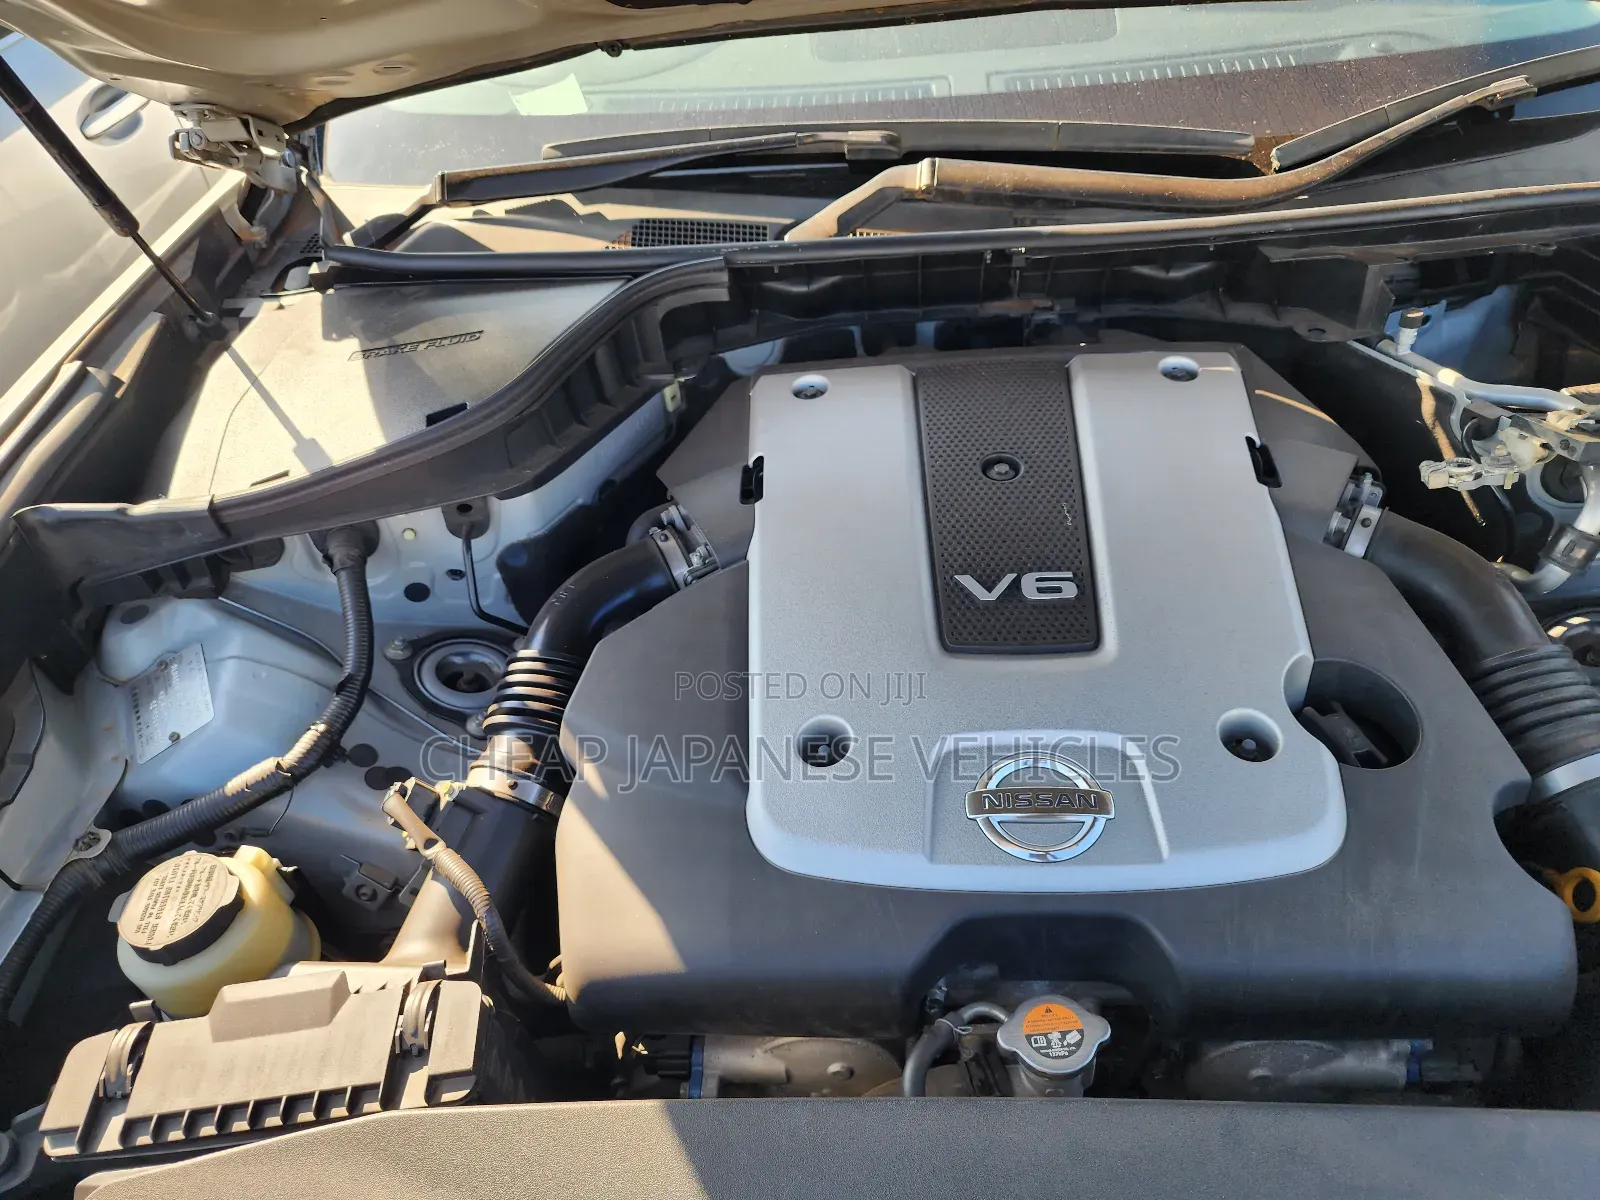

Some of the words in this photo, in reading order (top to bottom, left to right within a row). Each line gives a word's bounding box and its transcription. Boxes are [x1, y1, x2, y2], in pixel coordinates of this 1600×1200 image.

[347, 343, 419, 361] BRAKE
[423, 331, 484, 350] FLUID
[953, 571, 1079, 601] V6
[981, 792, 1099, 811] NISSAN
